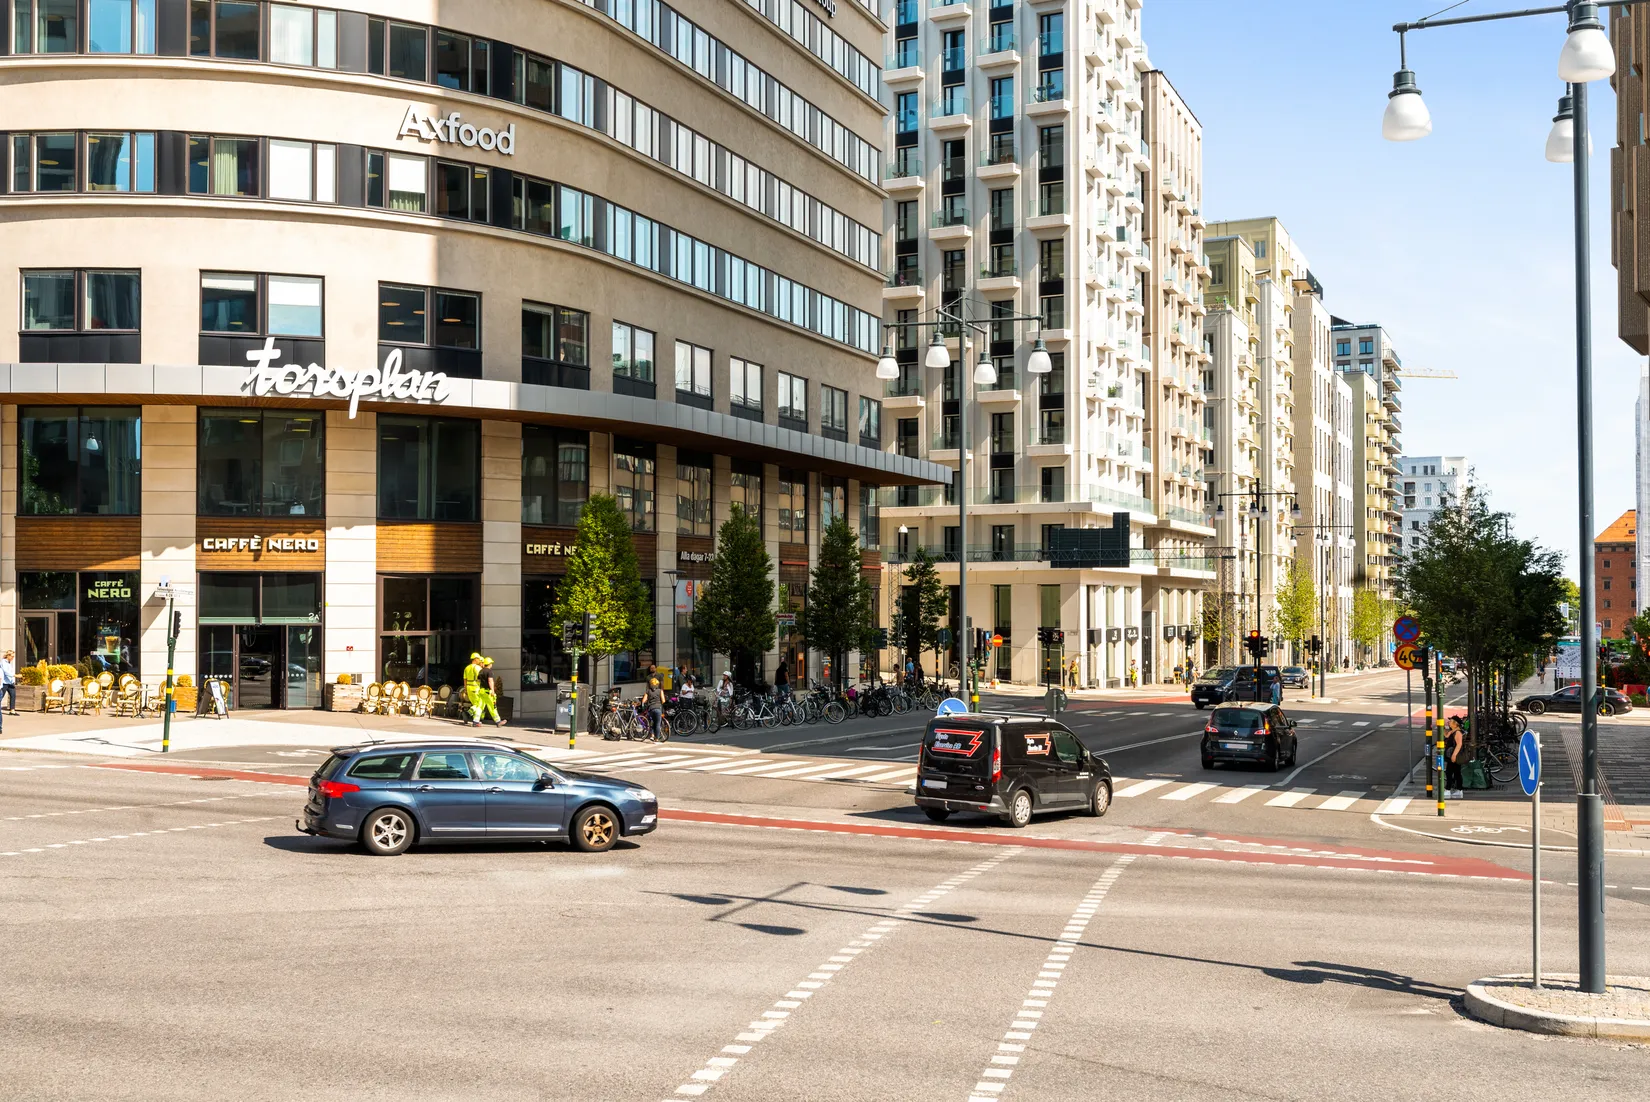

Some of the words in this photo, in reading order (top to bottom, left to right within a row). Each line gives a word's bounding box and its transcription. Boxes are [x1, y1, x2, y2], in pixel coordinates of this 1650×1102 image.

[399, 104, 516, 156] Axfood
[242, 337, 450, 420] torsplan
[203, 534, 262, 550] CAFFÈ
[268, 538, 319, 550] NERO
[526, 541, 561, 555] CAFFÈ
[680, 551, 690, 561] Alla
[690, 552, 704, 563] dagar
[94, 579, 124, 588] CAFFÈ
[87, 588, 131, 599] NERO
